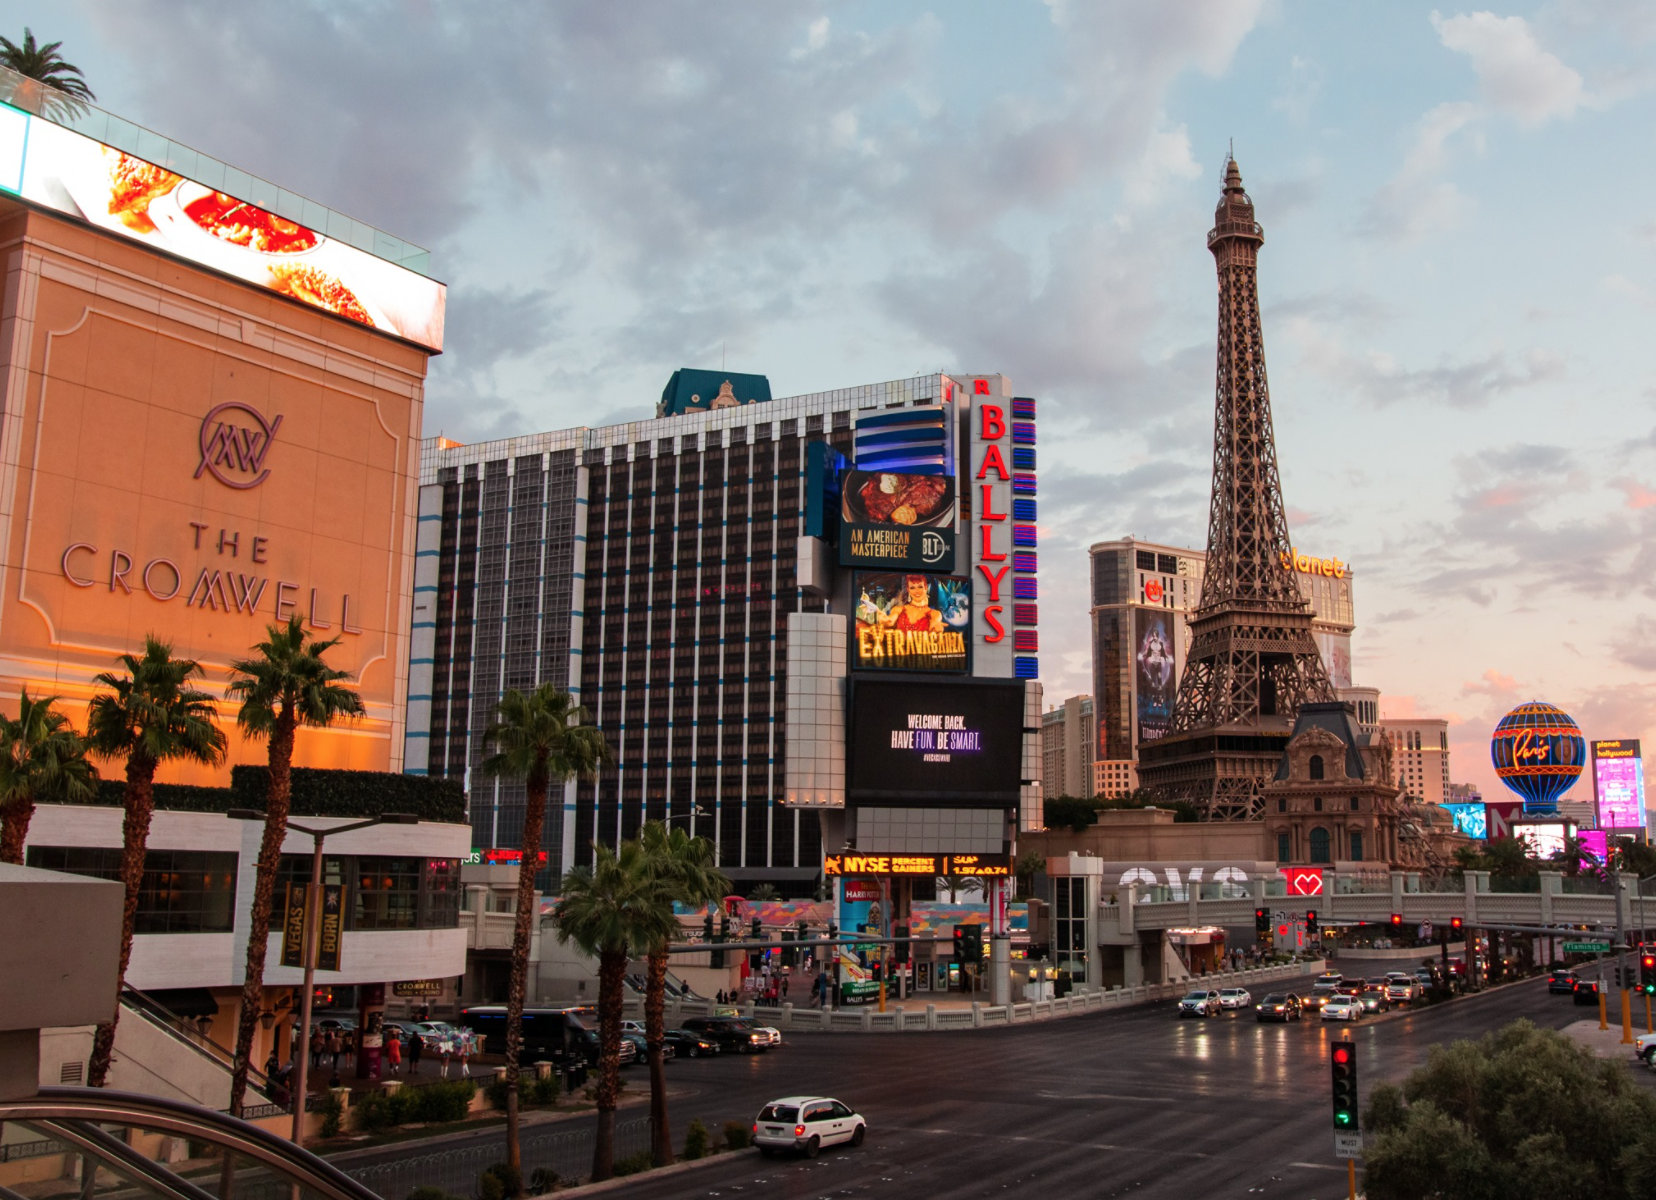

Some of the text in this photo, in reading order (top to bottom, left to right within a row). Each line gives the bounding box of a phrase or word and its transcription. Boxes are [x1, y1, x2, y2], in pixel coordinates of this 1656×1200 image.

[977, 404, 1011, 643] BALLYS
[190, 522, 269, 563] THE
[851, 529, 910, 544] AN AMERICAN
[851, 543, 908, 558] MASTERPIECE
[922, 538, 939, 555] BLT
[62, 542, 362, 635] CROMWELL
[860, 624, 965, 657] EXTRAVAGANZA
[908, 714, 966, 730] WELCOME BACK.
[891, 731, 981, 750] HAVE FUN. BE SMART.
[1597, 741, 1621, 749] planet
[1513, 728, 1550, 770] Paris
[1597, 749, 1634, 758] hollywood
[844, 857, 889, 872] NYSE
[892, 865, 935, 873] GAINERS
[846, 890, 866, 899] HARRY
[287, 907, 303, 952] VEGAS
[322, 914, 338, 952] BORN
[1566, 943, 1601, 952] Flamingo
